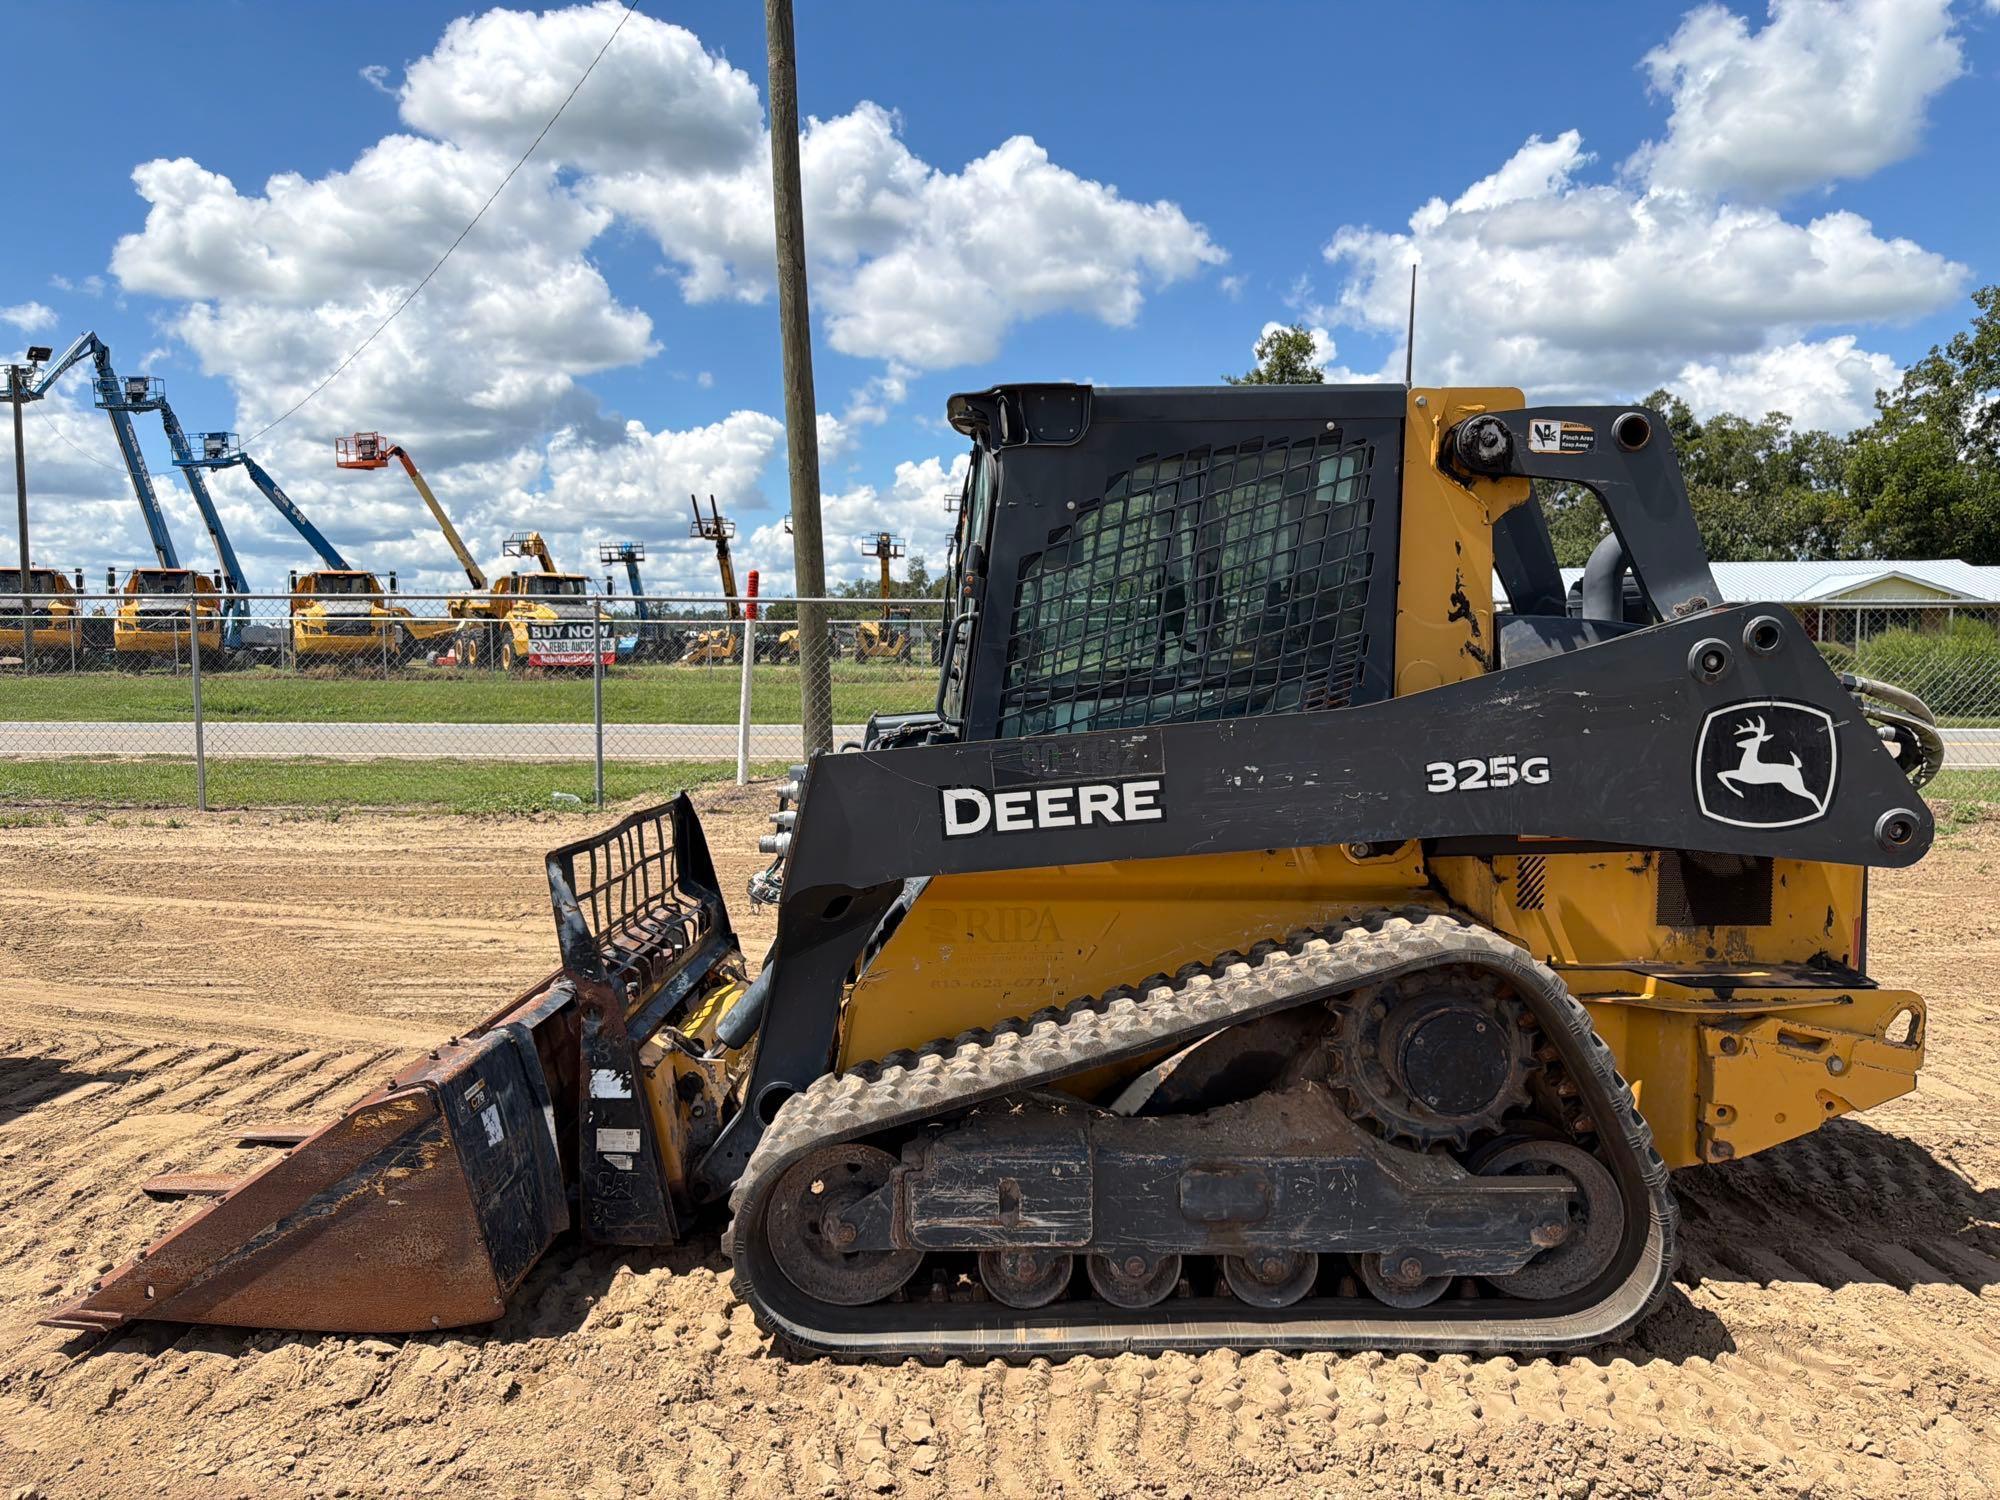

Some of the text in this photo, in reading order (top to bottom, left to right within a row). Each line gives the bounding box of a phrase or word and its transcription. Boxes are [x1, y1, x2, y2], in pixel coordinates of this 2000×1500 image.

[531, 625, 610, 639] BUY NOW
[549, 641, 570, 653] REBEL
[1426, 756, 1550, 793] 325G
[943, 780, 1162, 836] DEERE
[960, 905, 1065, 943] RIPA
